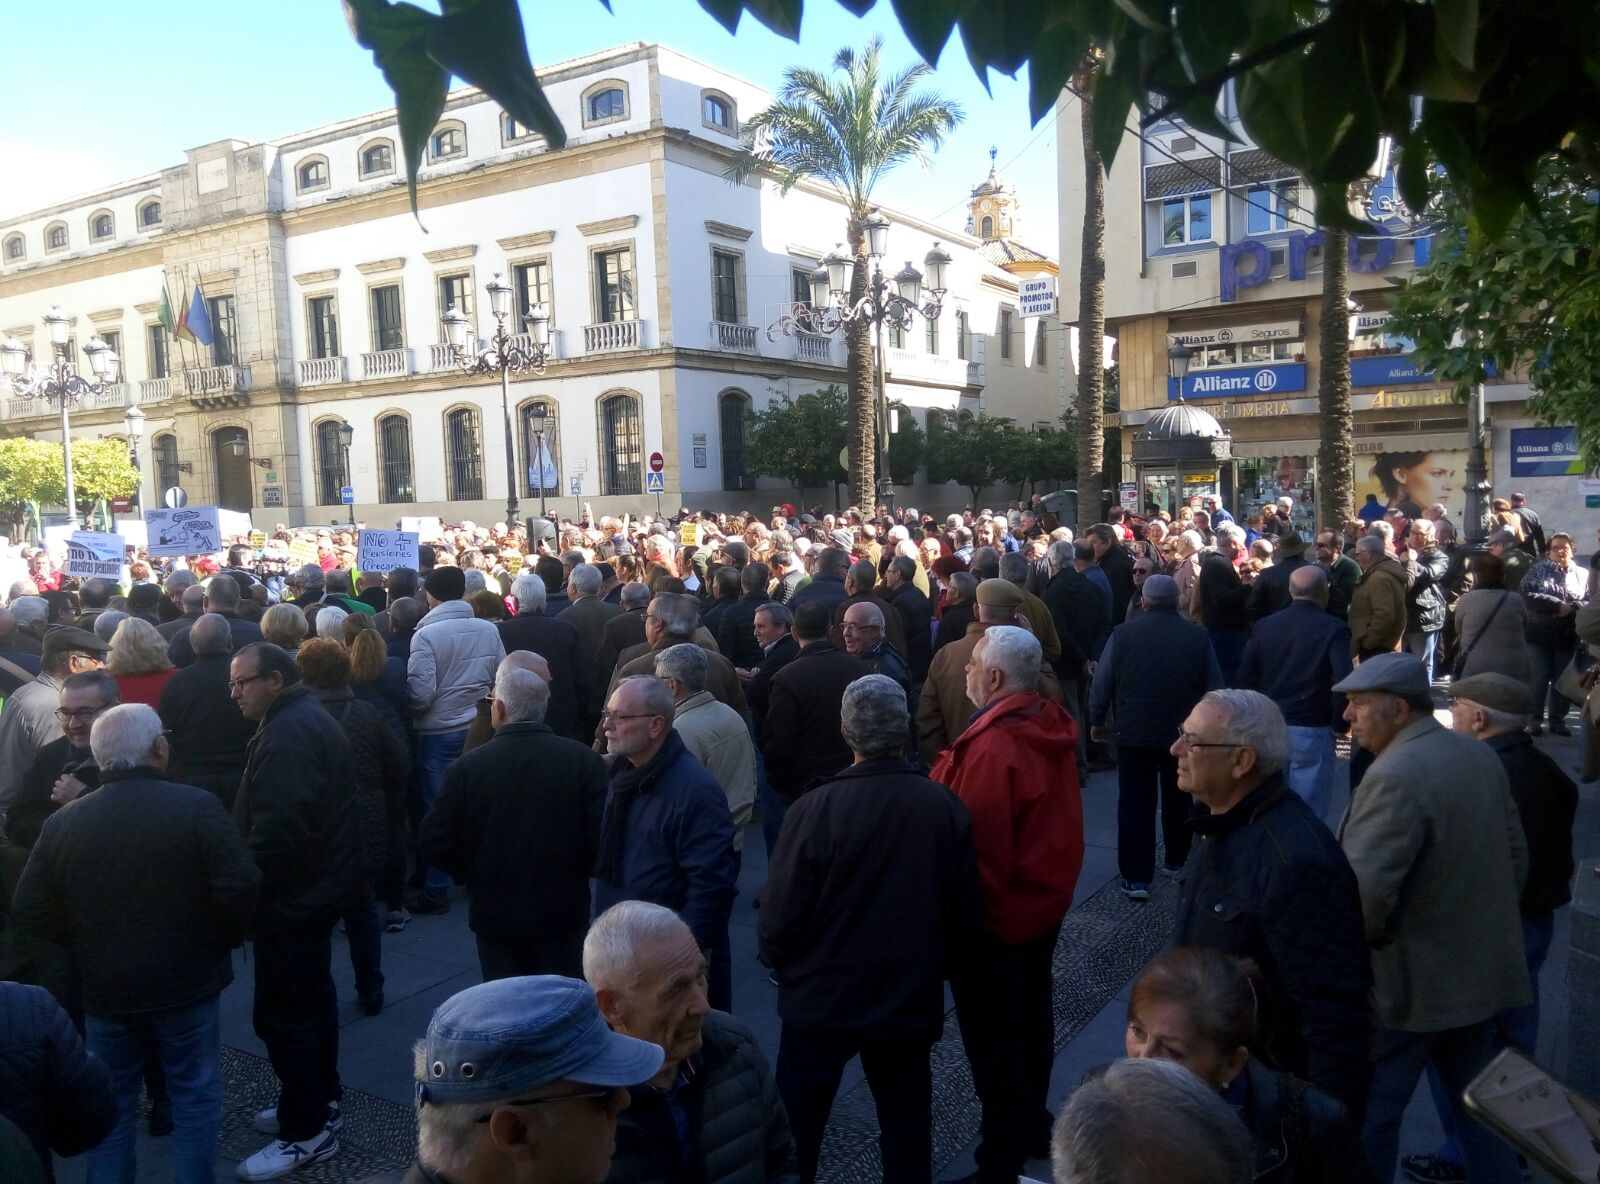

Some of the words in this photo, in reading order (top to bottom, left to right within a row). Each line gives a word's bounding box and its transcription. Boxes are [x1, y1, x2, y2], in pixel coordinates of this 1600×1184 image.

[1025, 282, 1047, 292] GRUPO
[1019, 291, 1054, 304] PROMOTOR
[1023, 306, 1027, 314] Y
[1029, 303, 1052, 313] ASESOR
[1251, 328, 1290, 339] Seguros
[1388, 369, 1414, 378] Allianz
[1192, 375, 1251, 393] Allianz
[1517, 445, 1549, 453] Allianz
[364, 533, 389, 548] NO
